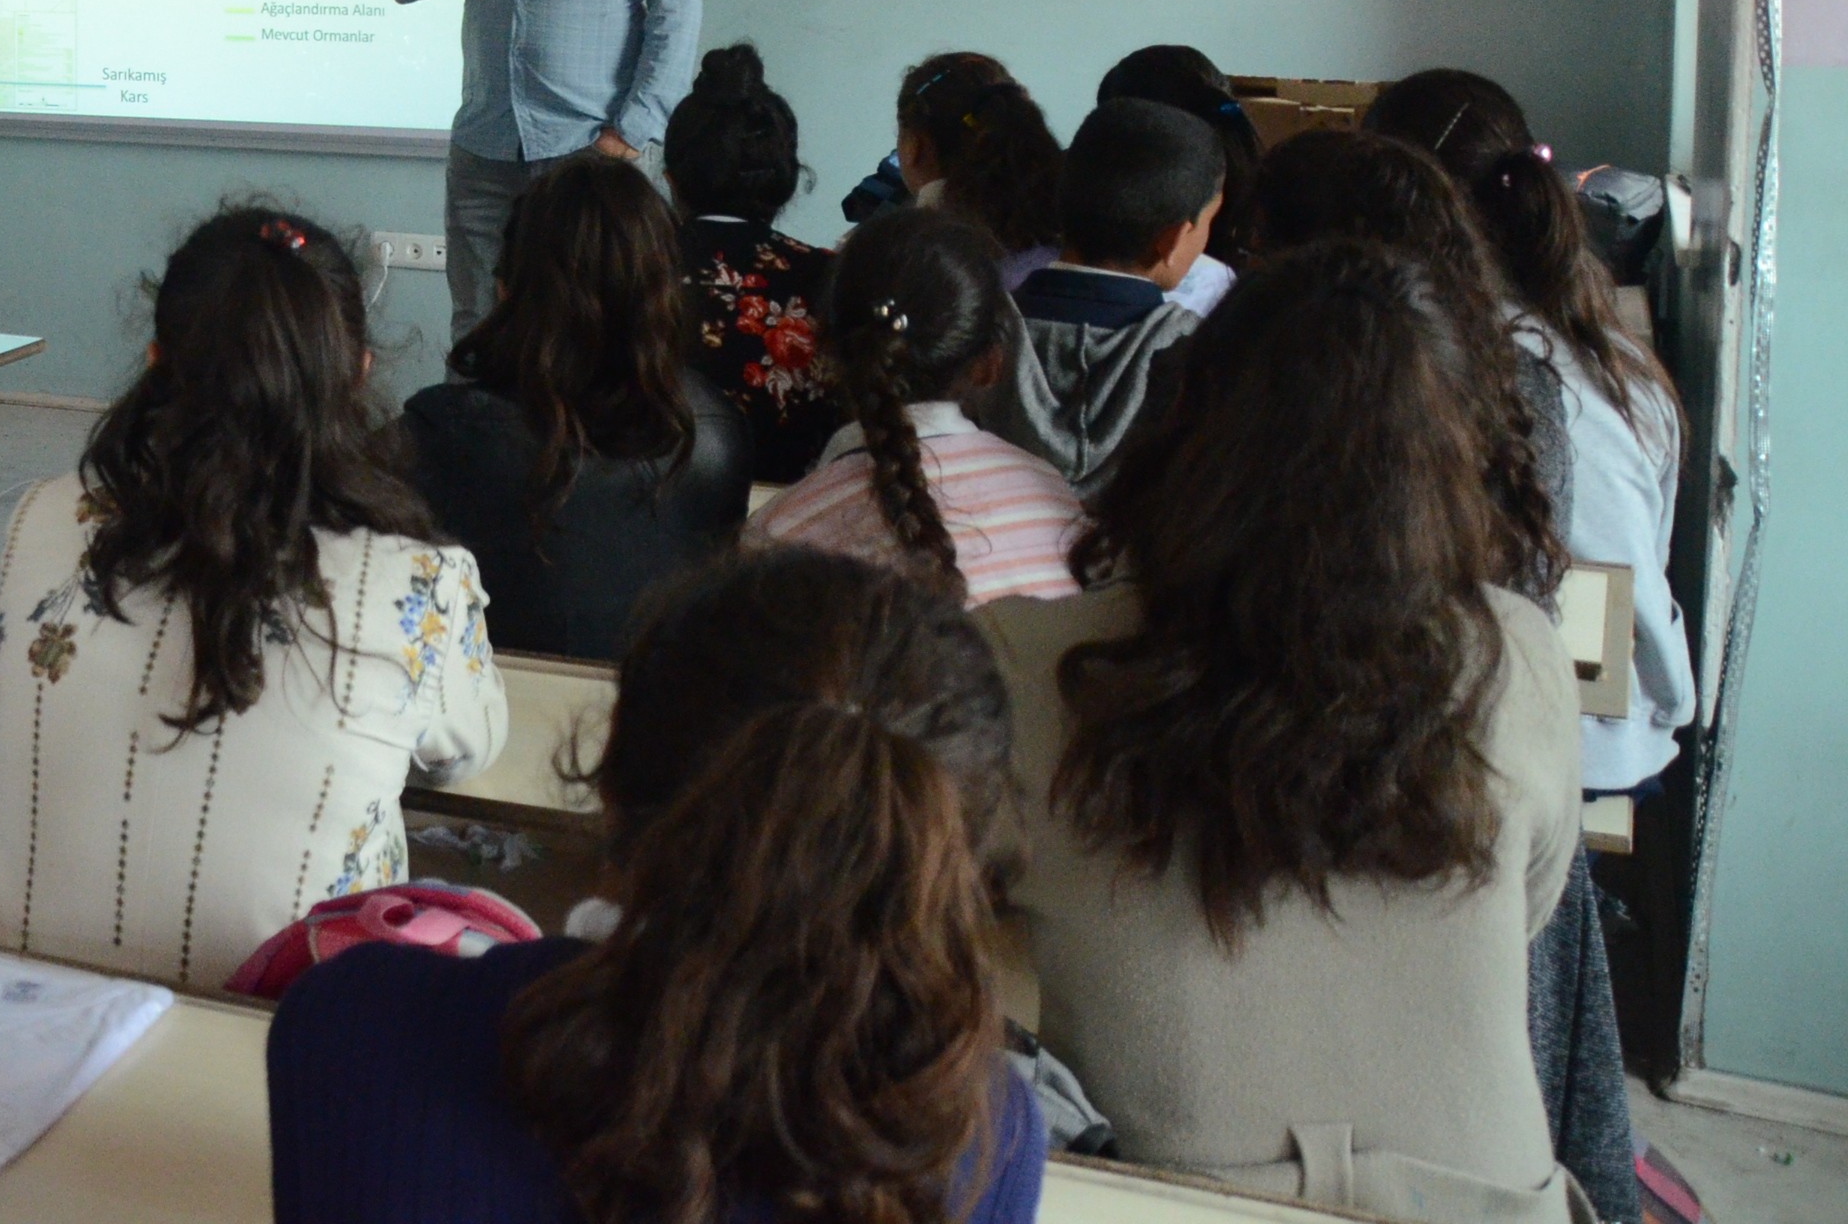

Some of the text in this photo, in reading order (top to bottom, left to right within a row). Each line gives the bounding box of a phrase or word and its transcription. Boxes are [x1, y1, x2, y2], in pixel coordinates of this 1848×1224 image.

[261, 1, 386, 17] Ağaçlandırma Alanı
[261, 28, 376, 43] Mevcut Ormanlar
[102, 67, 167, 86] Sarıkamış
[119, 89, 149, 104] Kars
